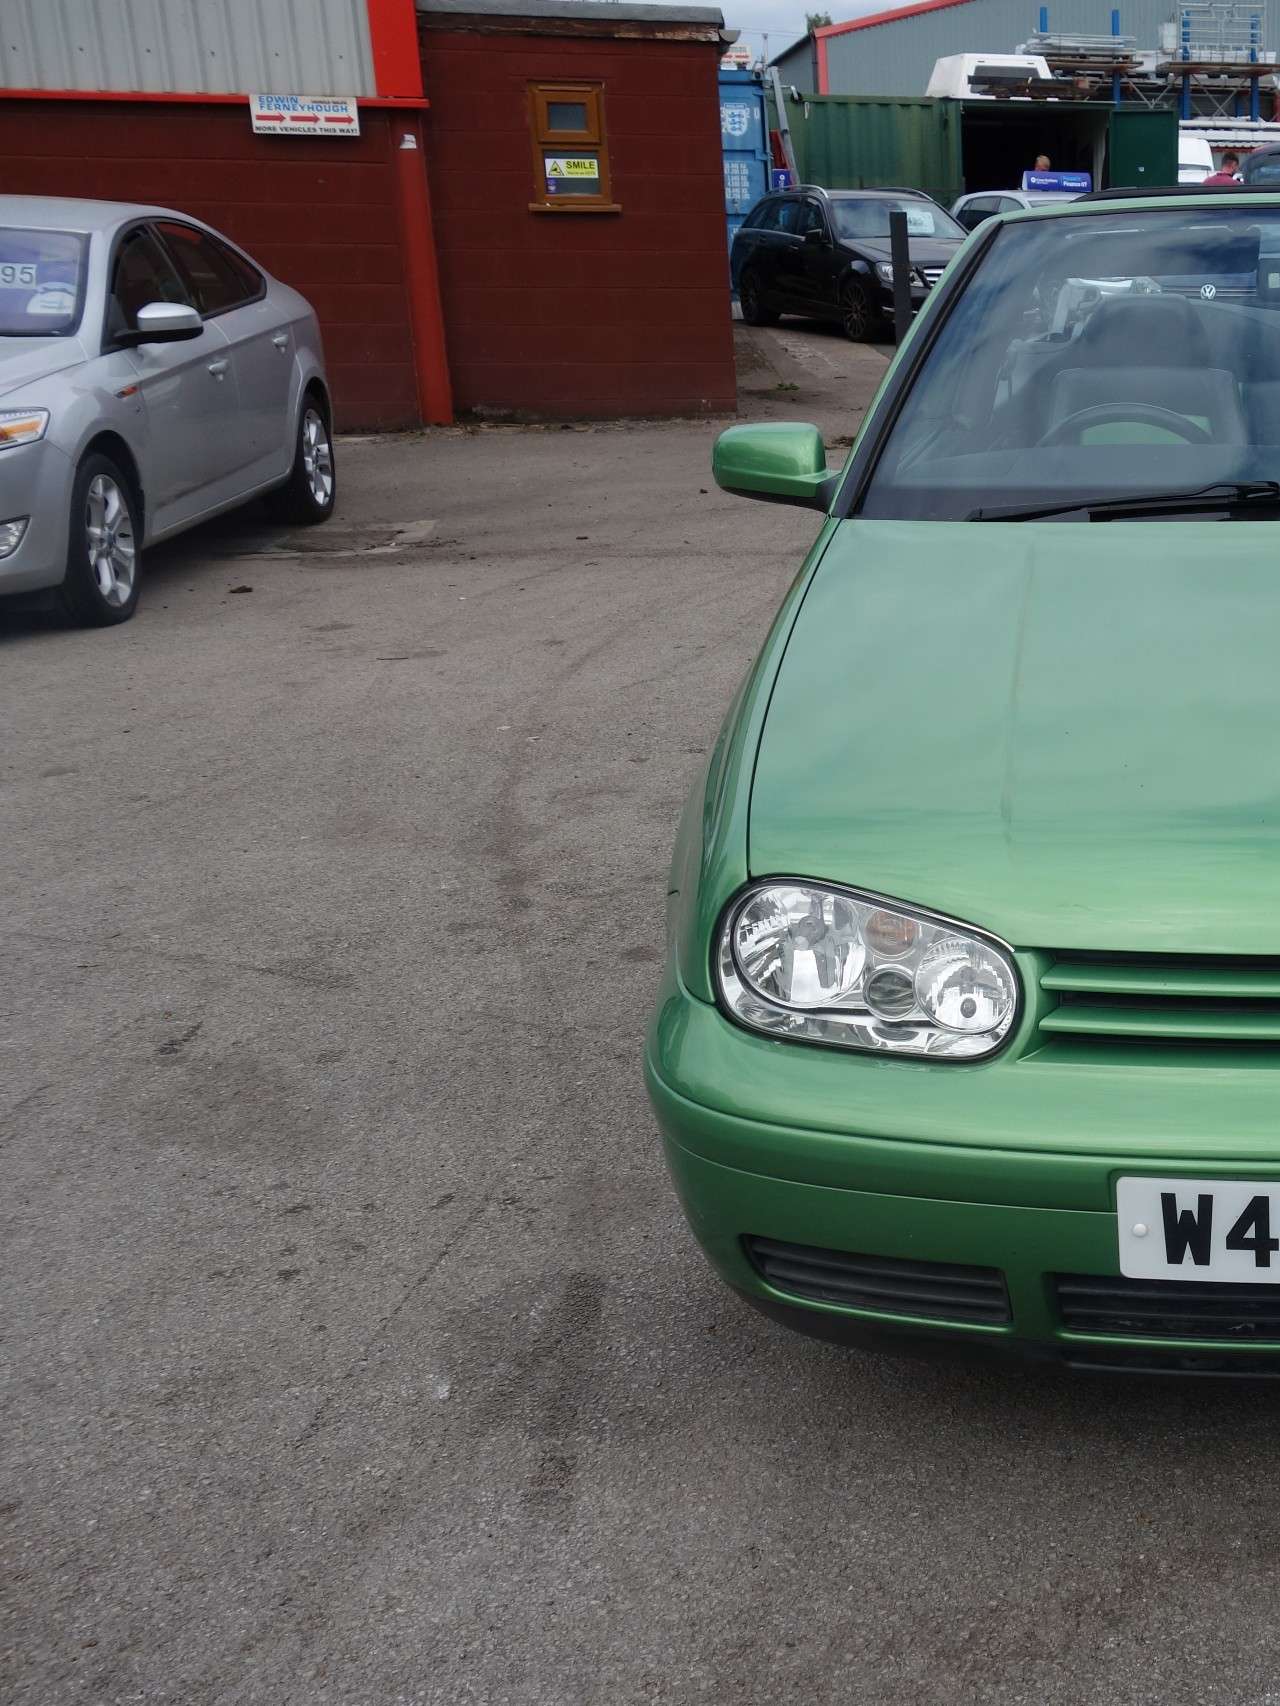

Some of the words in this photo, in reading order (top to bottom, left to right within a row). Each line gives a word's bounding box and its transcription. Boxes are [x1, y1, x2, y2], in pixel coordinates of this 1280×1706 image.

[258, 95, 299, 105] EDWIN
[260, 103, 349, 114] FERNEYHOUGH
[280, 126, 317, 134] VEHICLES
[338, 127, 358, 135] WAY!
[566, 161, 596, 170] SMILE
